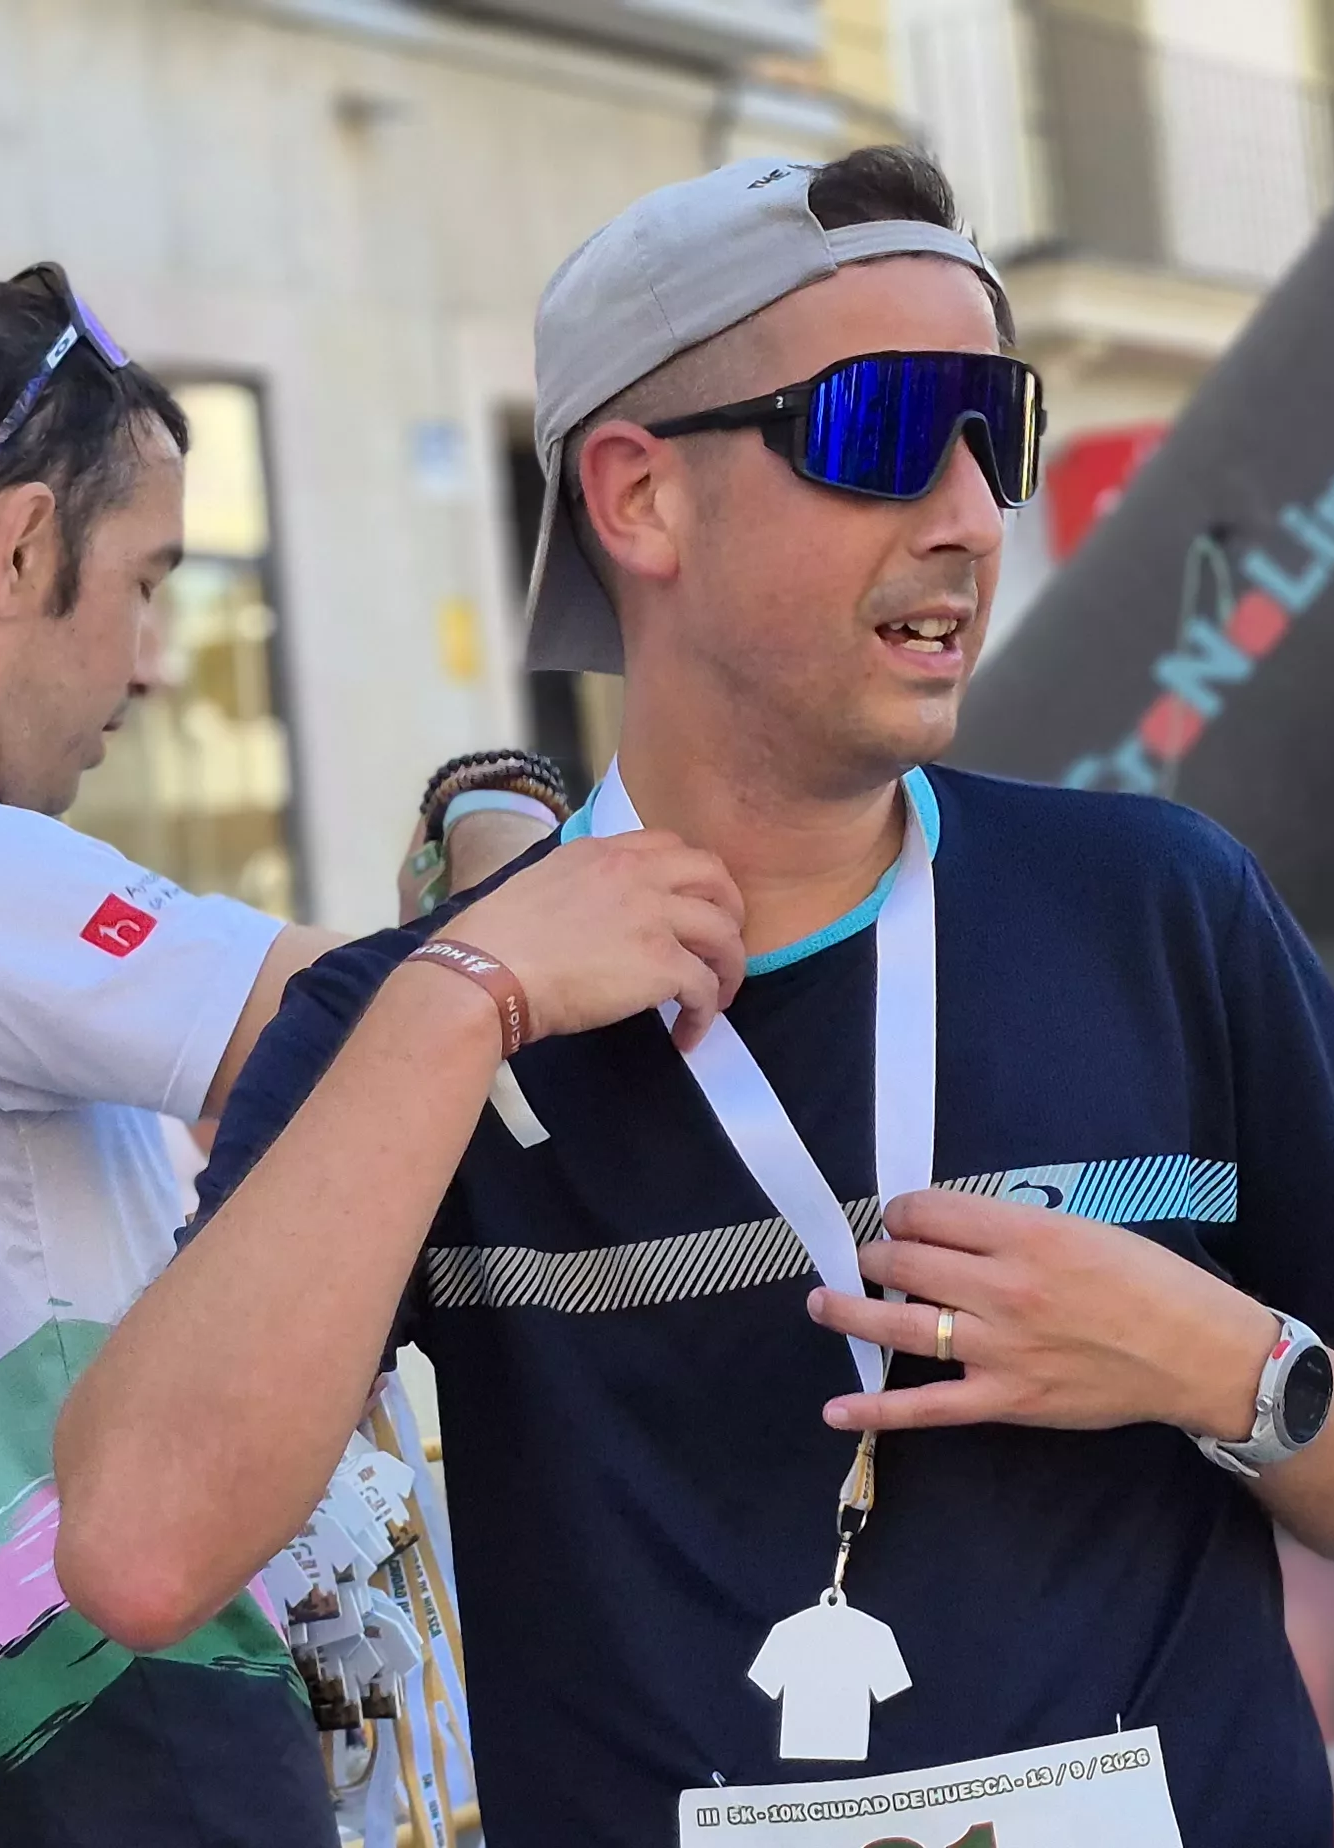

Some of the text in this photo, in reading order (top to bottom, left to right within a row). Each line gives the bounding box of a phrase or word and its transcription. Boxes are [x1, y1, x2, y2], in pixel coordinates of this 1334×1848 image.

[697, 1807, 720, 1826] III
[727, 1805, 756, 1825] 5K
[768, 1803, 806, 1823] 10K
[807, 1795, 890, 1820] CIUDAD
[893, 1790, 925, 1811] DE
[928, 1775, 1014, 1806] HUESCA
